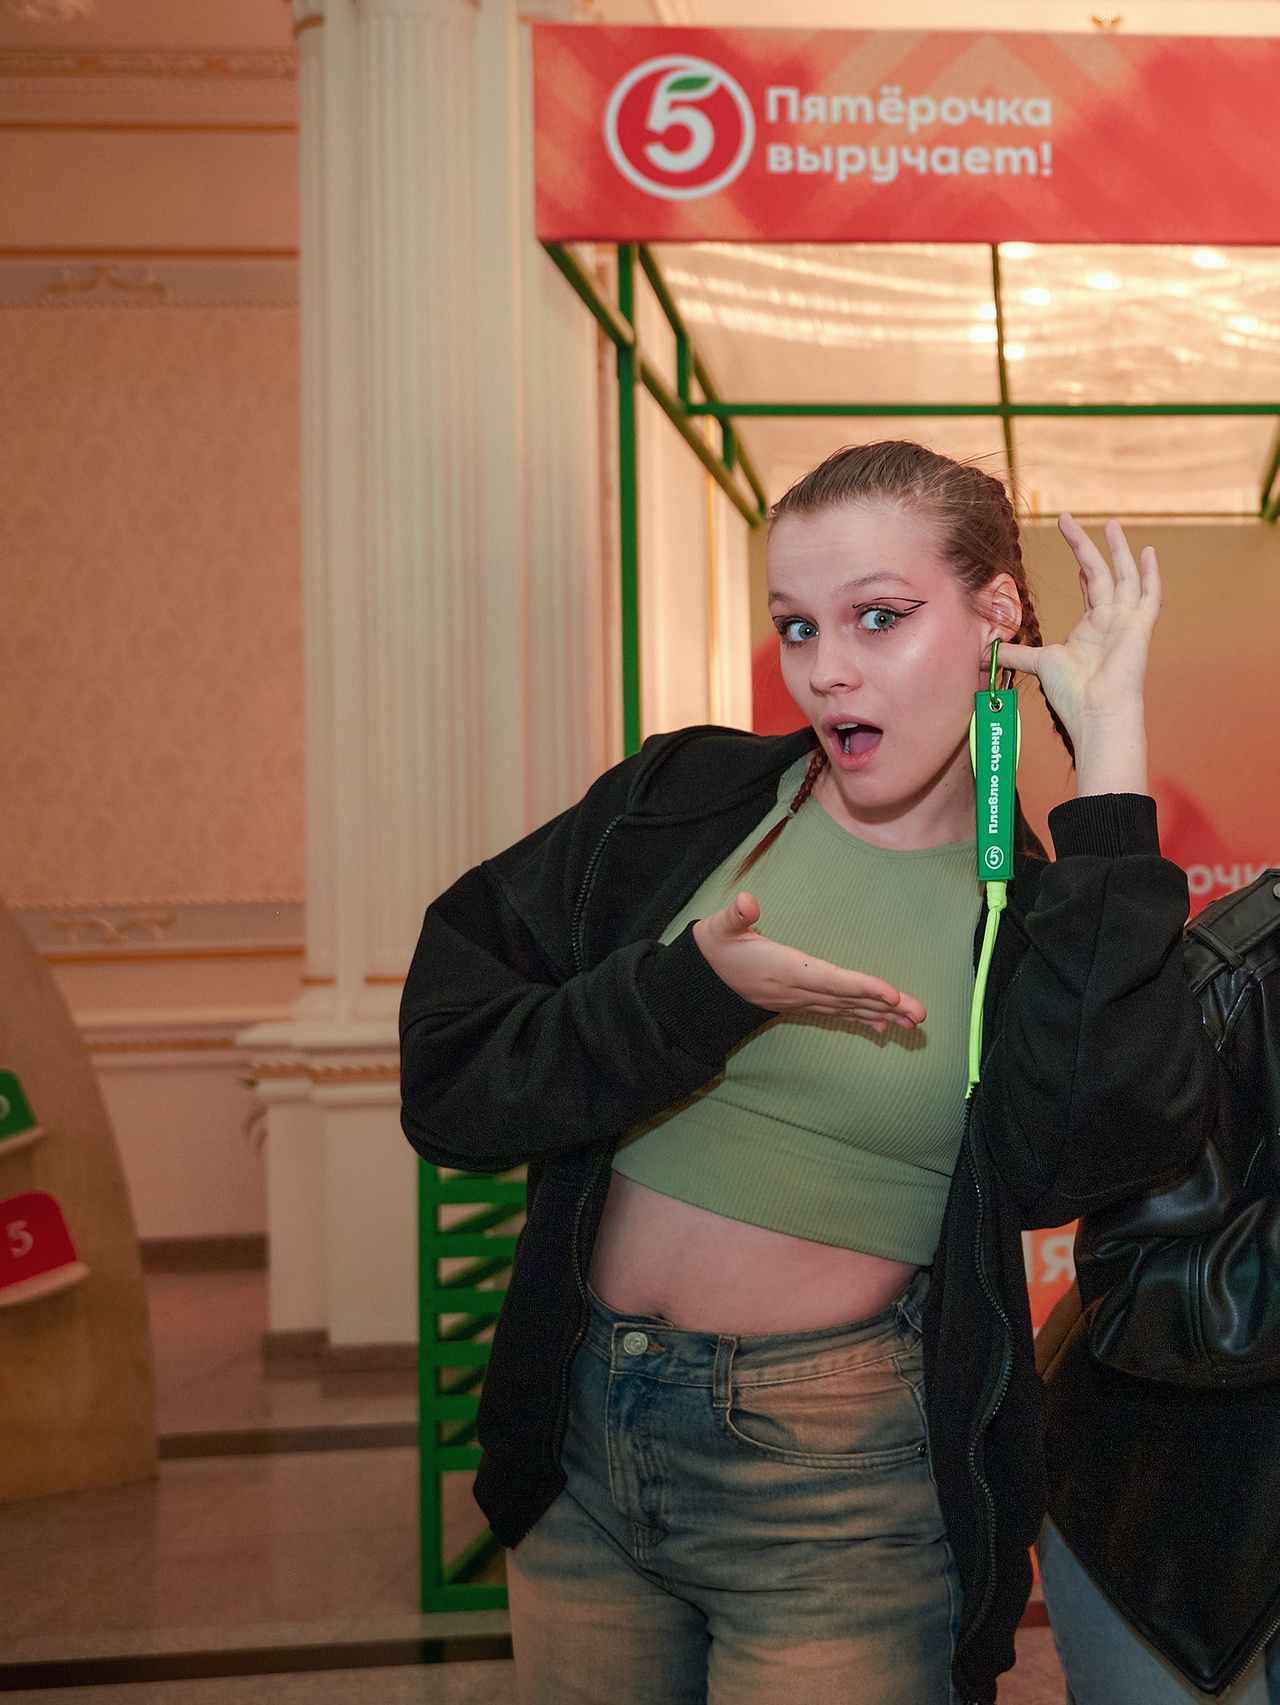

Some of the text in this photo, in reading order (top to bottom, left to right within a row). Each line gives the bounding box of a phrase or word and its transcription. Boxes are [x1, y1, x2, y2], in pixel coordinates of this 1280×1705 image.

[765, 86, 1053, 133] Пятёрочка
[766, 141, 1053, 183] выручает!
[988, 722, 1003, 834] Плавлю сцену!
[6, 1219, 34, 1258] 5
